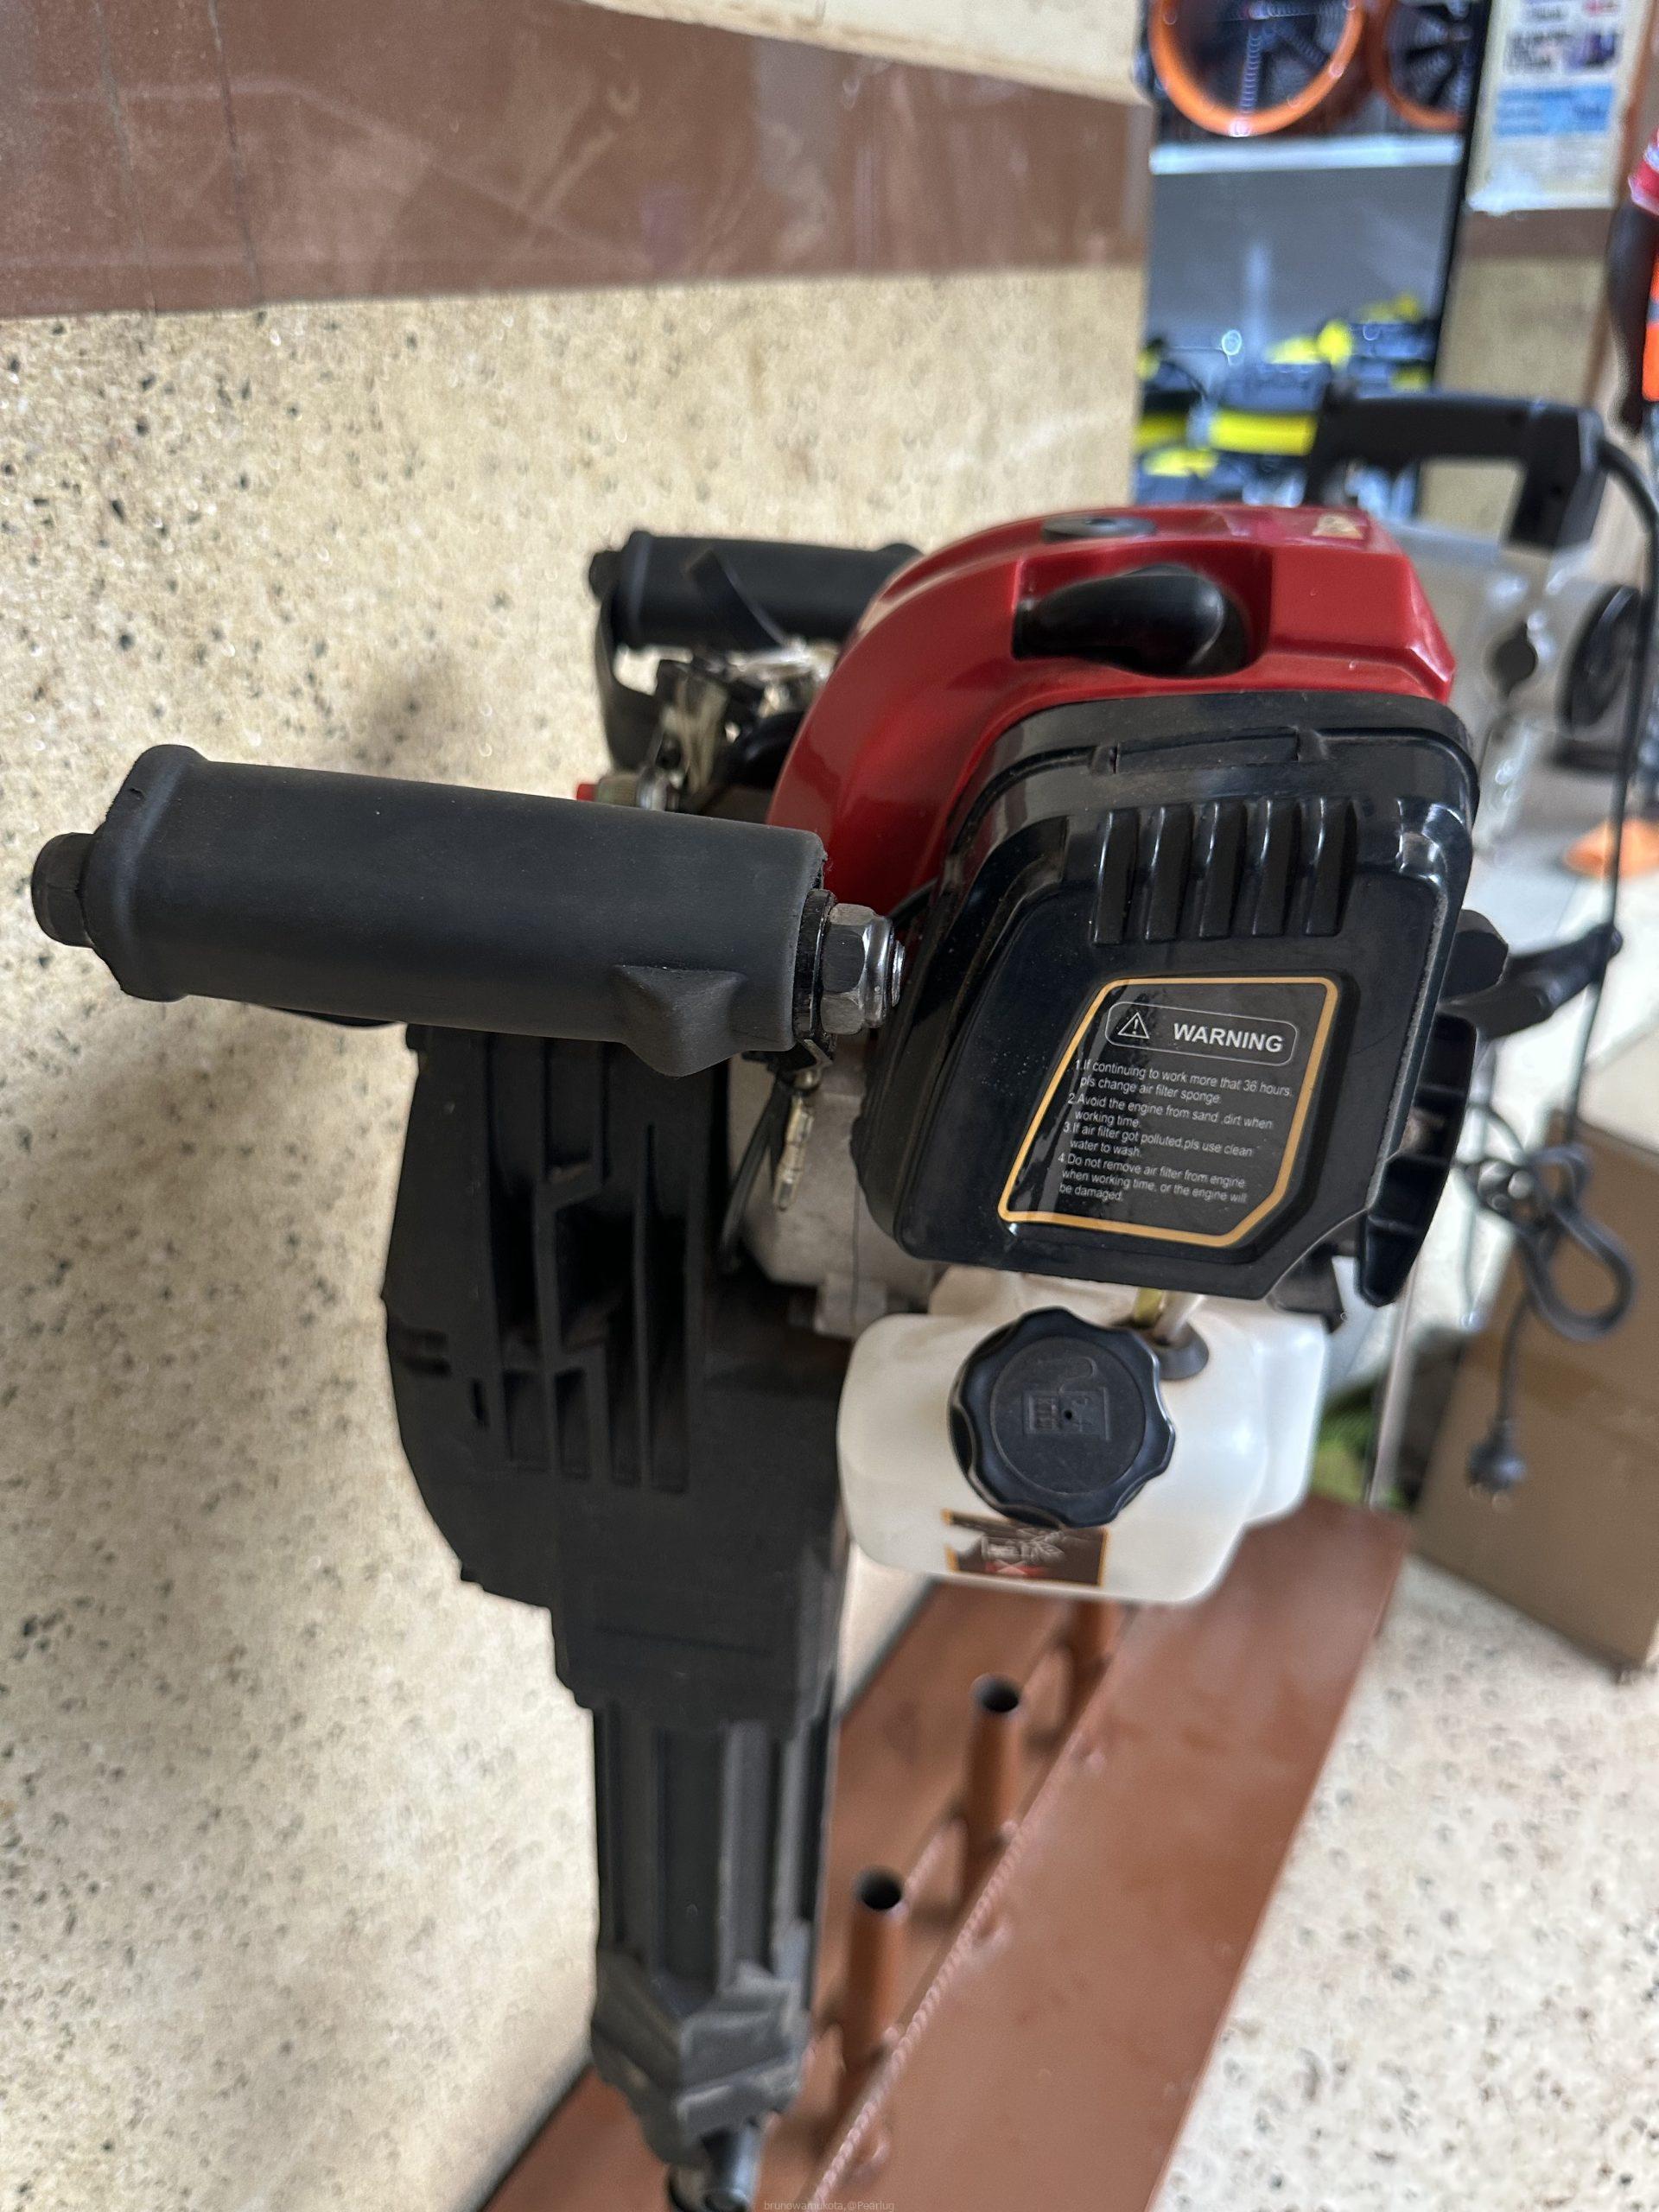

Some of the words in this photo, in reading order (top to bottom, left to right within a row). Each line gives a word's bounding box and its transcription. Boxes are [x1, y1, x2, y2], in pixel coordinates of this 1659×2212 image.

[1173, 1022, 1283, 1052] WARNING
[1080, 1074, 1096, 1088] pls
[1098, 1077, 1137, 1094] change
[1139, 1084, 1154, 1094] air
[1156, 1084, 1179, 1098] filter
[1093, 1061, 1146, 1080] continuing
[1149, 1068, 1159, 1079] to
[1162, 1071, 1187, 1084] work
[1189, 1074, 1217, 1087] more
[1220, 1077, 1241, 1090] that
[1243, 1079, 1257, 1092] 36
[1075, 1111, 1115, 1127] working
[1109, 1097, 1125, 1110] the
[1128, 1102, 1163, 1116] engine
[1166, 1104, 1189, 1118] from
[1192, 1109, 1218, 1122] sand
[1244, 1116, 1274, 1129] when
[1071, 1140, 1098, 1151] water
[1101, 1141, 1111, 1153] to
[1082, 1125, 1096, 1135] air
[1097, 1125, 1121, 1139] filter
[1122, 1131, 1140, 1143] got
[1202, 1141, 1222, 1154] use
[1224, 1144, 1253, 1157] clean
[1059, 1183, 1072, 1193] be
[1062, 1169, 1089, 1181] when
[1091, 1174, 1131, 1190] working
[1160, 1183, 1172, 1192] or
[1173, 1184, 1190, 1196] the
[1192, 1188, 1228, 1202] engine
[1230, 1193, 1248, 1203] will
[1084, 1158, 1103, 1169] not
[1103, 1160, 1141, 1174] remove
[1143, 1165, 1158, 1176] air
[1160, 1166, 1184, 1179] filter
[1184, 1169, 1208, 1183] from
[1210, 1175, 1245, 1189] engine
